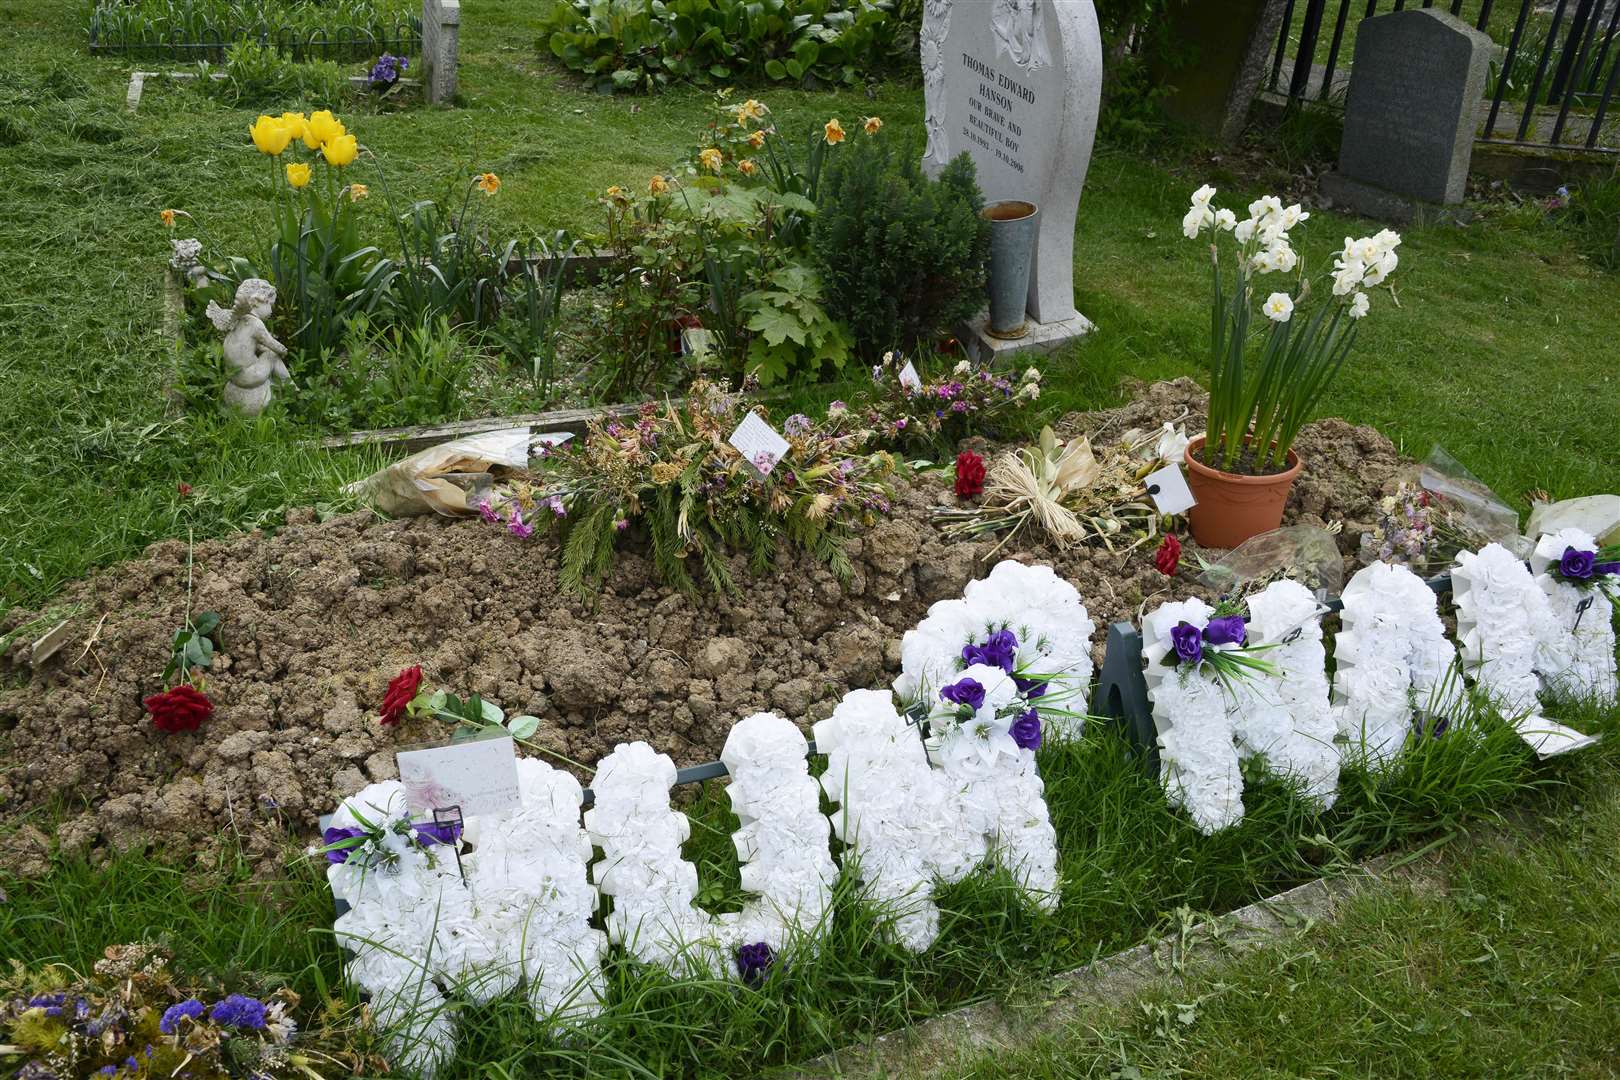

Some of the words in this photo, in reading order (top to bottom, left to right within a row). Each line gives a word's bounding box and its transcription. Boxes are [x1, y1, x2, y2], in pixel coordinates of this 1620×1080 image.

[962, 53, 995, 81] THOMAS
[998, 73, 1035, 104] EDWARD
[979, 83, 1013, 112] HANSON
[969, 97, 982, 112] OUR
[984, 106, 1006, 127] BRAVE
[1007, 121, 1022, 137] AND
[969, 114, 1003, 143] BEAUTIFUL
[1005, 137, 1019, 152] BOY
